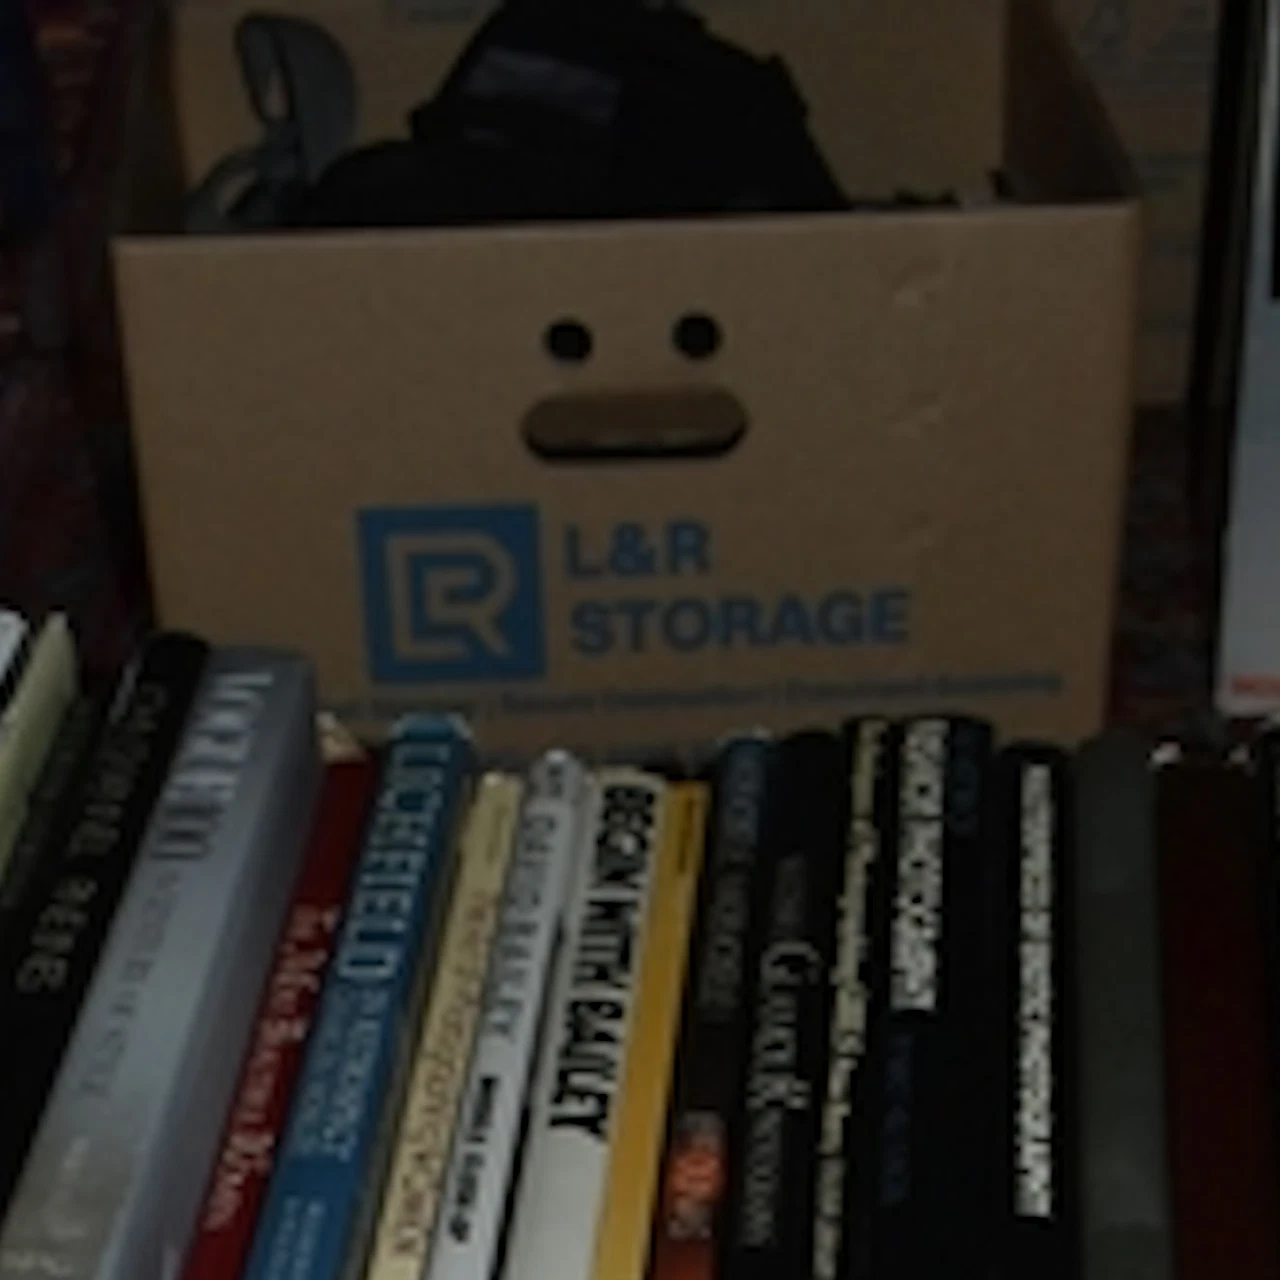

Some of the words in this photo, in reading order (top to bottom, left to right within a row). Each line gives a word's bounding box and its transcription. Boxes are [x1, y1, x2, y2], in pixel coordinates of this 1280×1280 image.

[564, 521, 713, 579] L&R
[568, 590, 912, 656] STORAGE
[592, 784, 654, 890] BEGIN
[571, 899, 633, 992] WITH
[549, 999, 624, 1141] BAILEY
